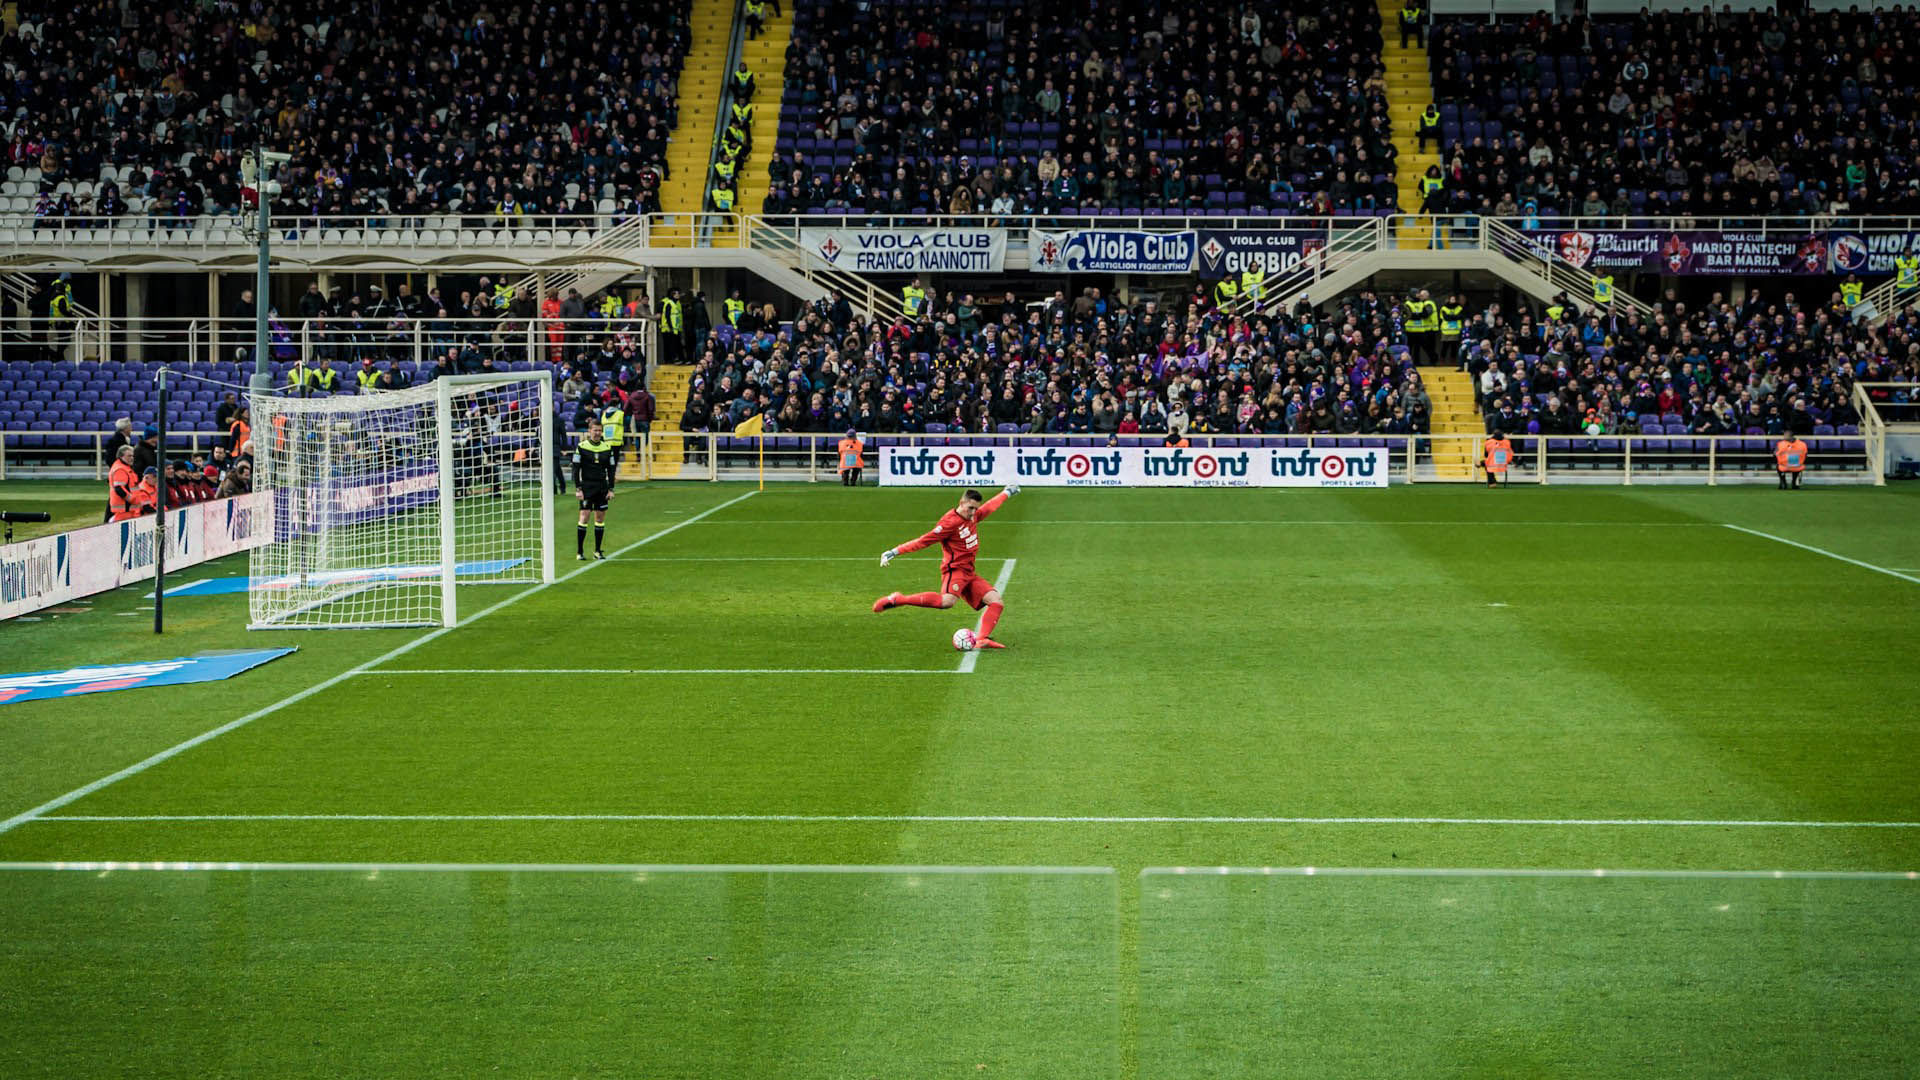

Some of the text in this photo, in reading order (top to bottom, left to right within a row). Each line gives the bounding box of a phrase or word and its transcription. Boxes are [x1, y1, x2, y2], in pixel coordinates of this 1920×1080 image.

[857, 234, 991, 249] VIOLA CLUB
[1085, 233, 1189, 261] Viola Club
[1229, 236, 1263, 246] VIOLA
[1266, 236, 1296, 246] CLUB
[1596, 233, 1659, 254] Bianchi
[1722, 234, 1745, 242] VIOLA
[1692, 242, 1796, 255] MARIO FANTECHI
[856, 251, 991, 270] FRANCO NANNOTTI
[1138, 262, 1188, 271] FIORENTINO
[1225, 251, 1301, 273] GUBBIO
[1592, 255, 1643, 267] Montuori
[1707, 255, 1780, 266] BAR MARISA
[890, 448, 995, 478] infront
[1017, 448, 1122, 478] infront
[1144, 449, 1249, 479] infront
[1271, 449, 1377, 479] infront
